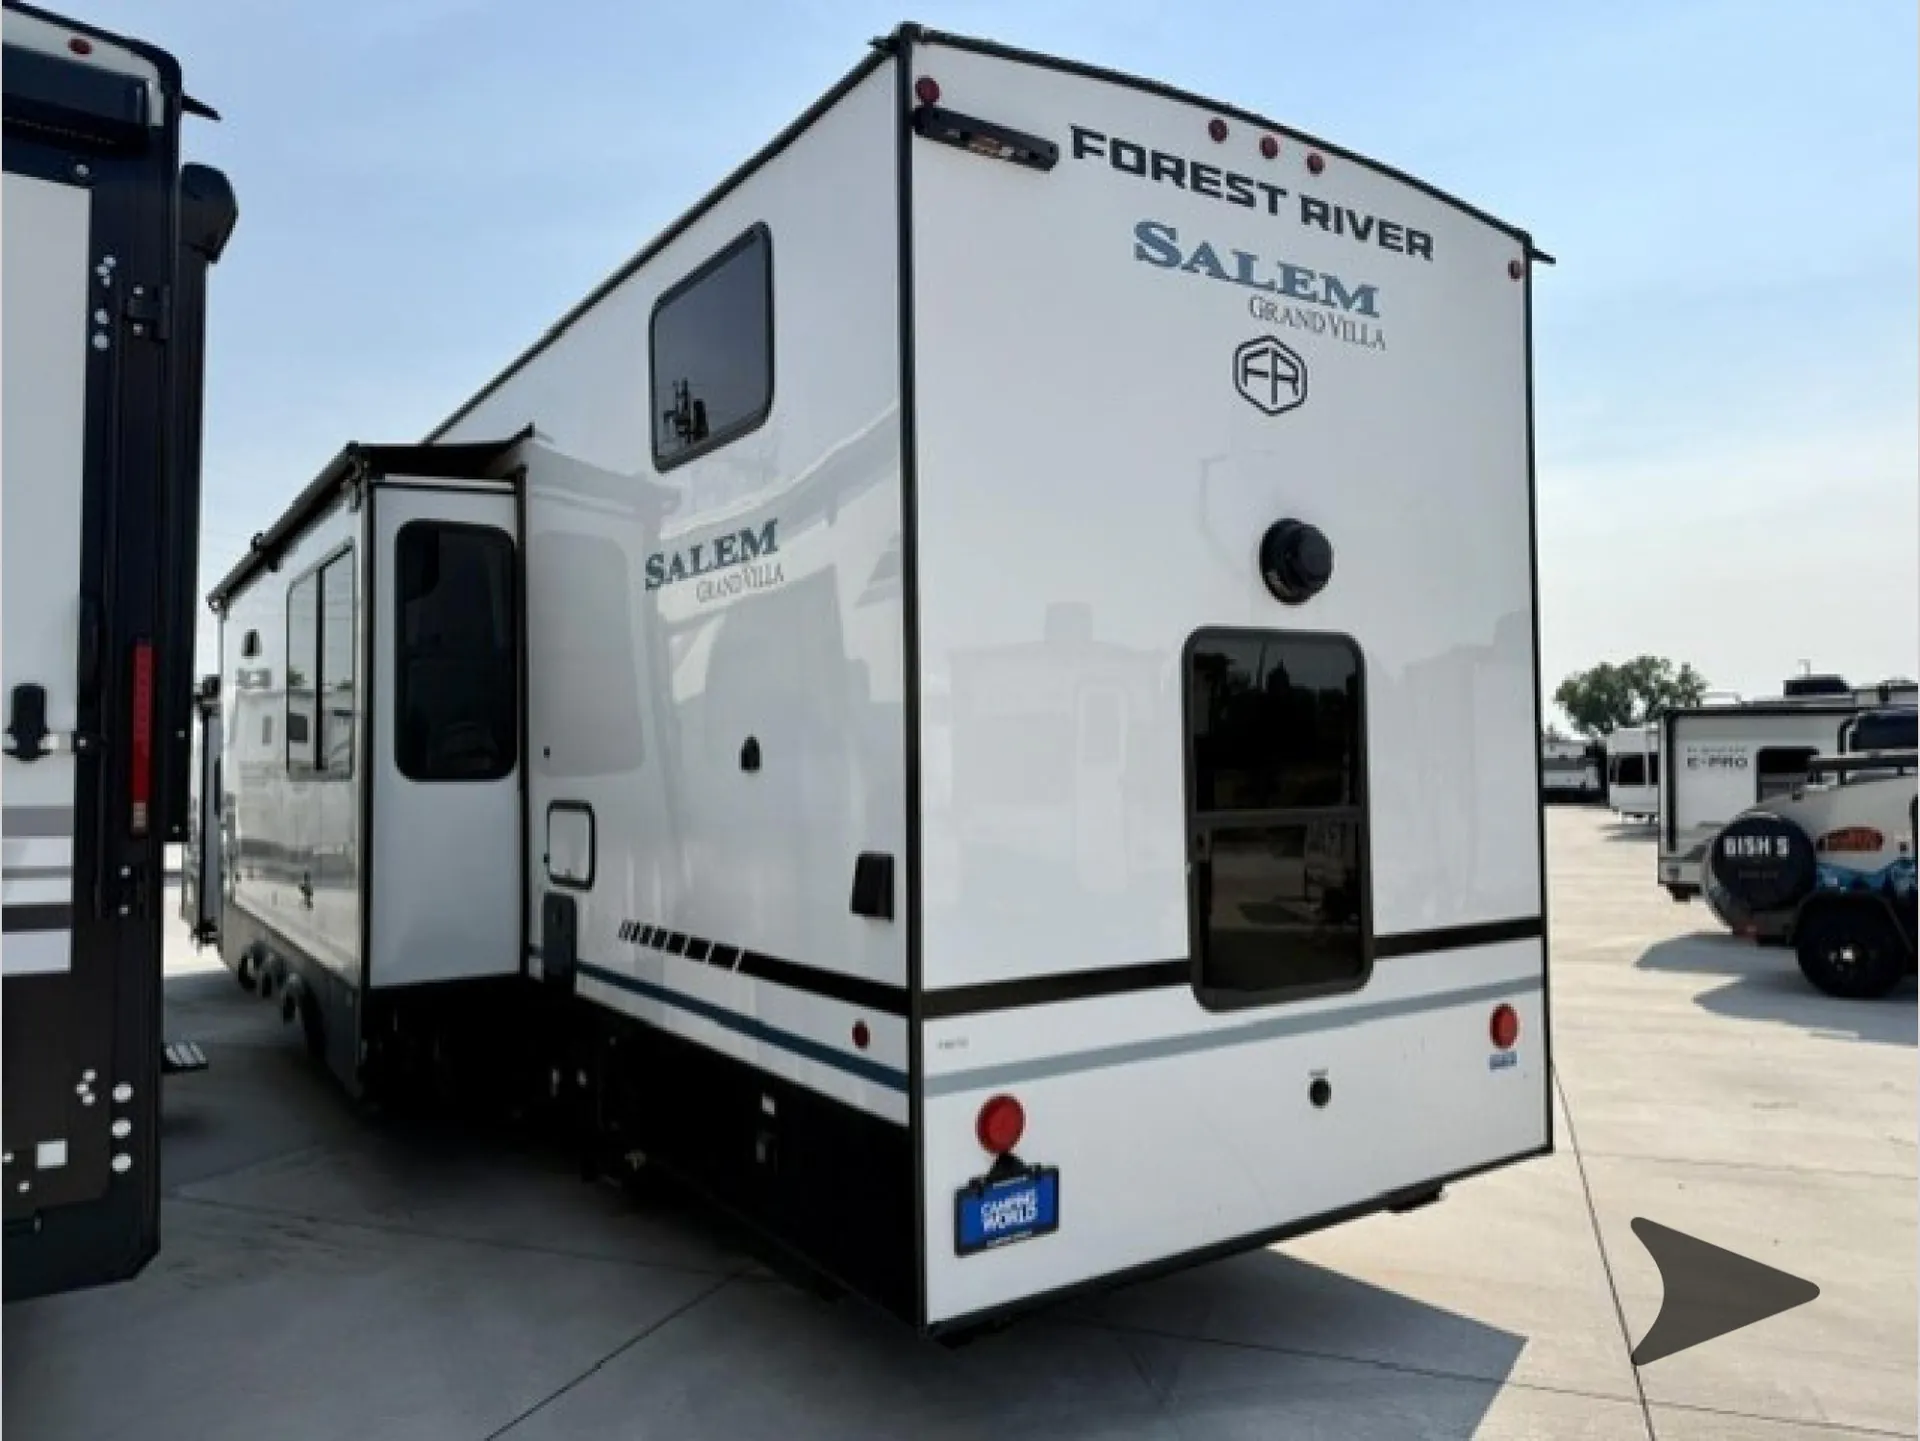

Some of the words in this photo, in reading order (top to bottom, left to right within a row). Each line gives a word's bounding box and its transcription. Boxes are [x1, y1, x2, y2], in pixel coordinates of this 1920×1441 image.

[1071, 124, 1287, 215] FOREST
[1299, 194, 1433, 261] RIVER
[1134, 220, 1379, 318] SALEM
[645, 517, 779, 591] SALEM
[1723, 835, 1790, 859] BISHS
